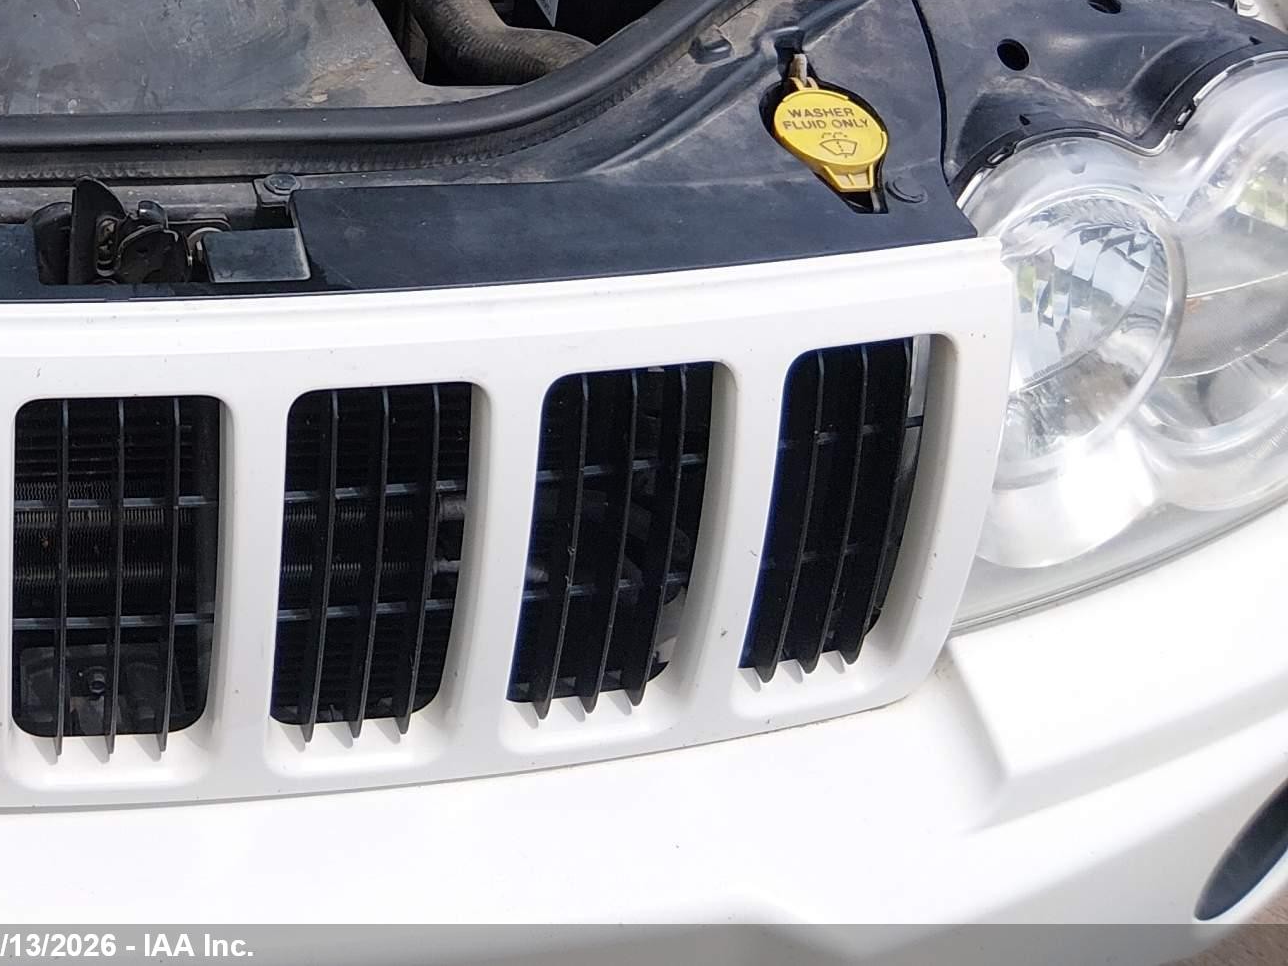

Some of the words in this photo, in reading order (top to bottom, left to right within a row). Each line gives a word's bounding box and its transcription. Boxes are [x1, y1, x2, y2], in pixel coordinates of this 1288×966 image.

[787, 107, 855, 118] WASHER
[782, 120, 827, 130] FLUID
[831, 118, 870, 129] ONLY
